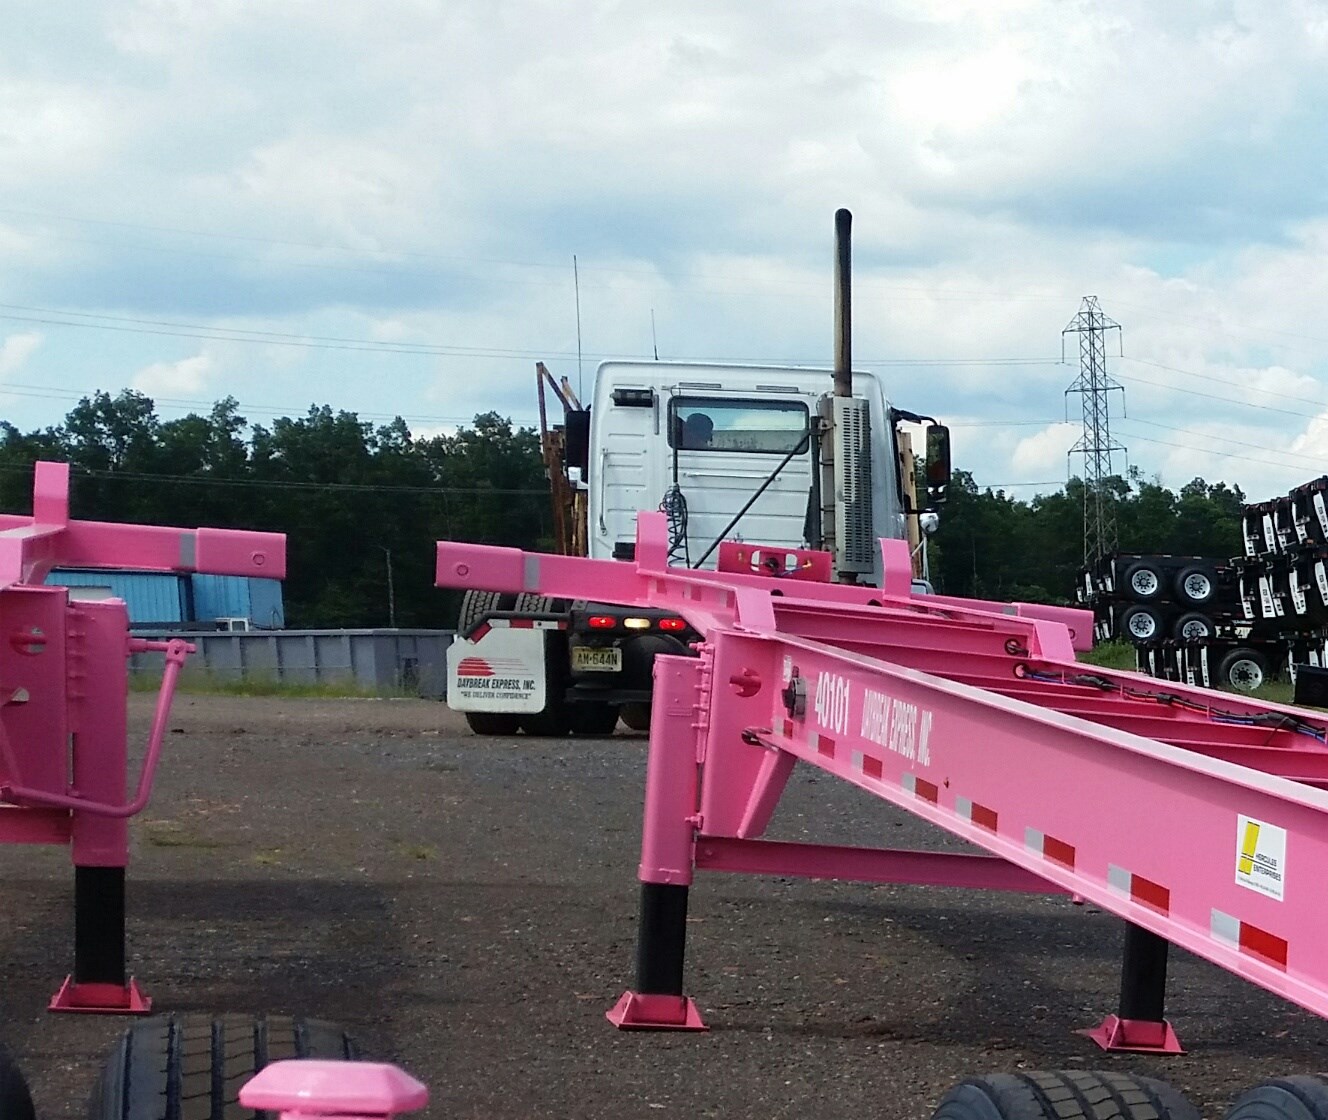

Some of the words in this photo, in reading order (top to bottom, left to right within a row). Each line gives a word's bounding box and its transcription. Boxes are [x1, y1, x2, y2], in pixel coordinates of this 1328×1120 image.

[457, 677, 490, 689] DAYBREAK
[491, 678, 521, 690] EXPRESS,
[523, 679, 536, 691] INC.
[815, 671, 850, 736] 40101
